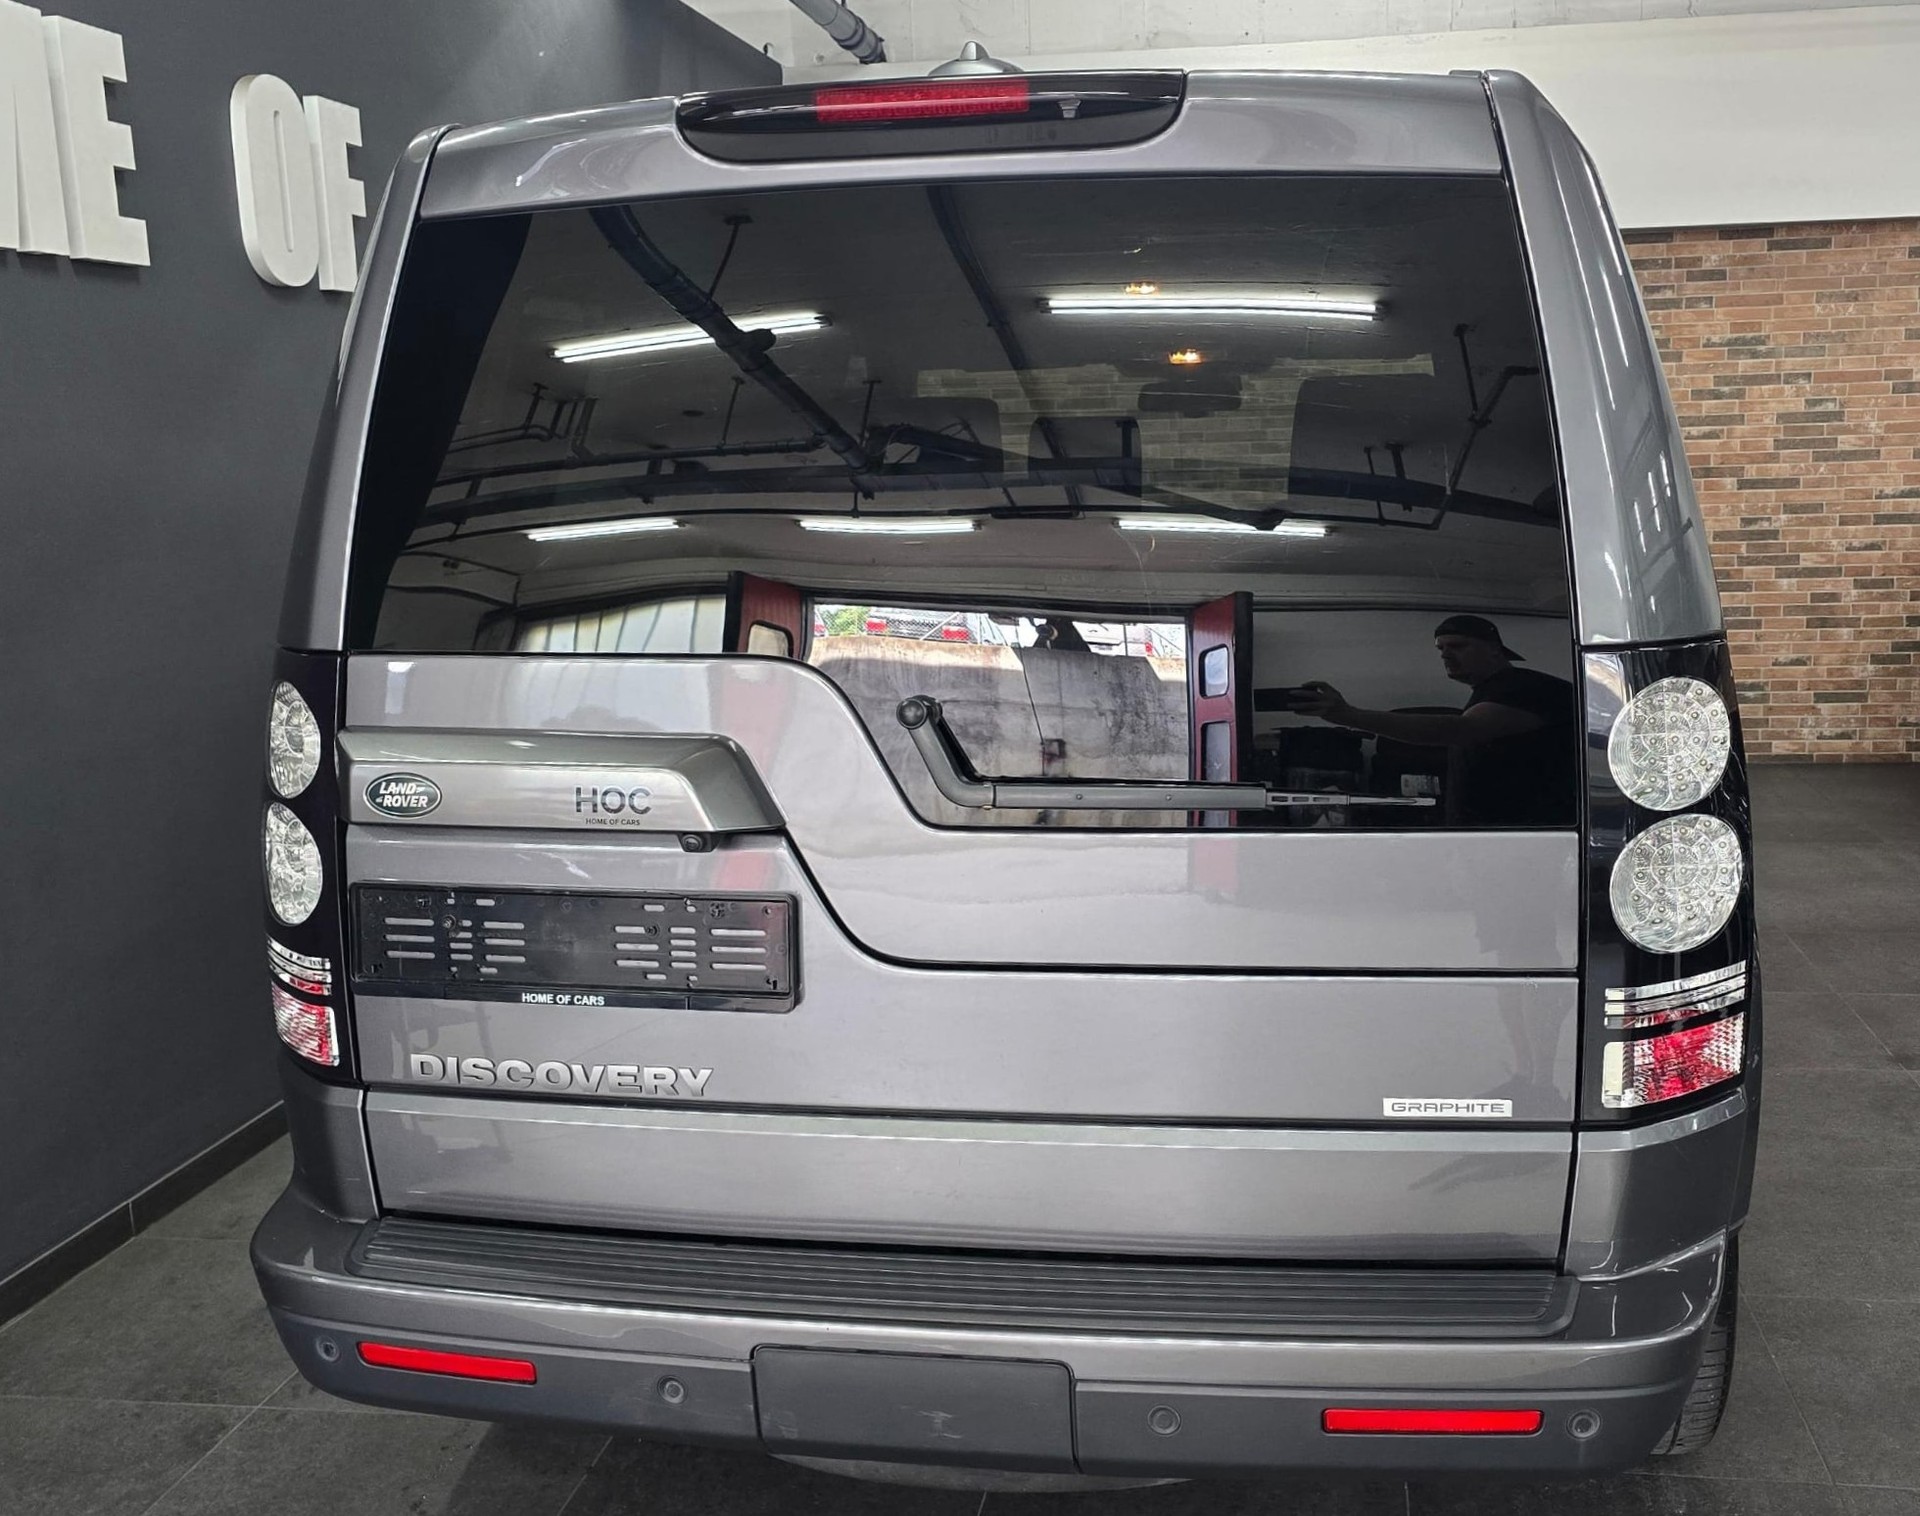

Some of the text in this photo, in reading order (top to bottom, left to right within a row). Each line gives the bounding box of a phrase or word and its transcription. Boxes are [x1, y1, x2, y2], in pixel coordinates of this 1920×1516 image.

[230, 73, 367, 293] OF
[379, 781, 417, 794] LAND
[383, 795, 429, 808] ROVER
[575, 787, 652, 815] HOC
[521, 992, 605, 1006] HOME OF CARS
[409, 1053, 715, 1097] DISCOVERY
[1391, 1102, 1506, 1114] GRAPHITE
